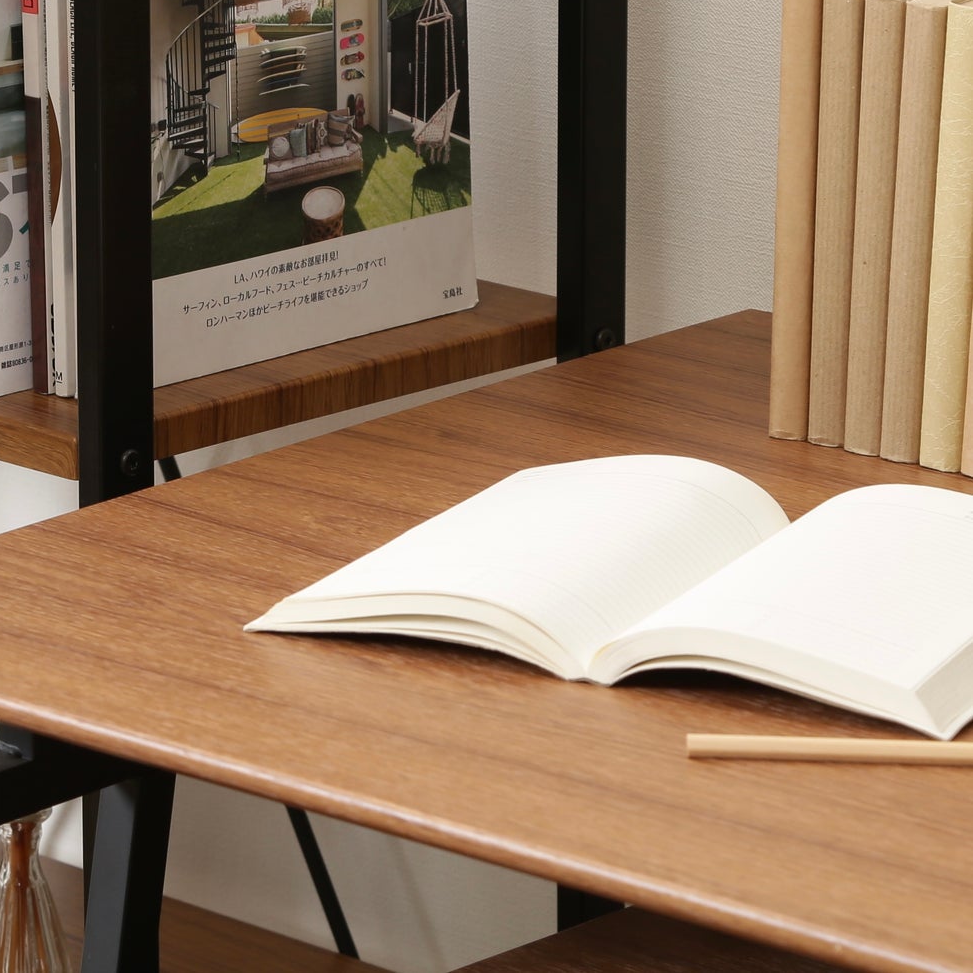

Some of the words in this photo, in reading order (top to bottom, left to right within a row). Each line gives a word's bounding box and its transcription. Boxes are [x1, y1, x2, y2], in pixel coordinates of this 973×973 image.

[206, 279, 368, 328] ロンハーマンほかビーチライフを堪能できるショップ
